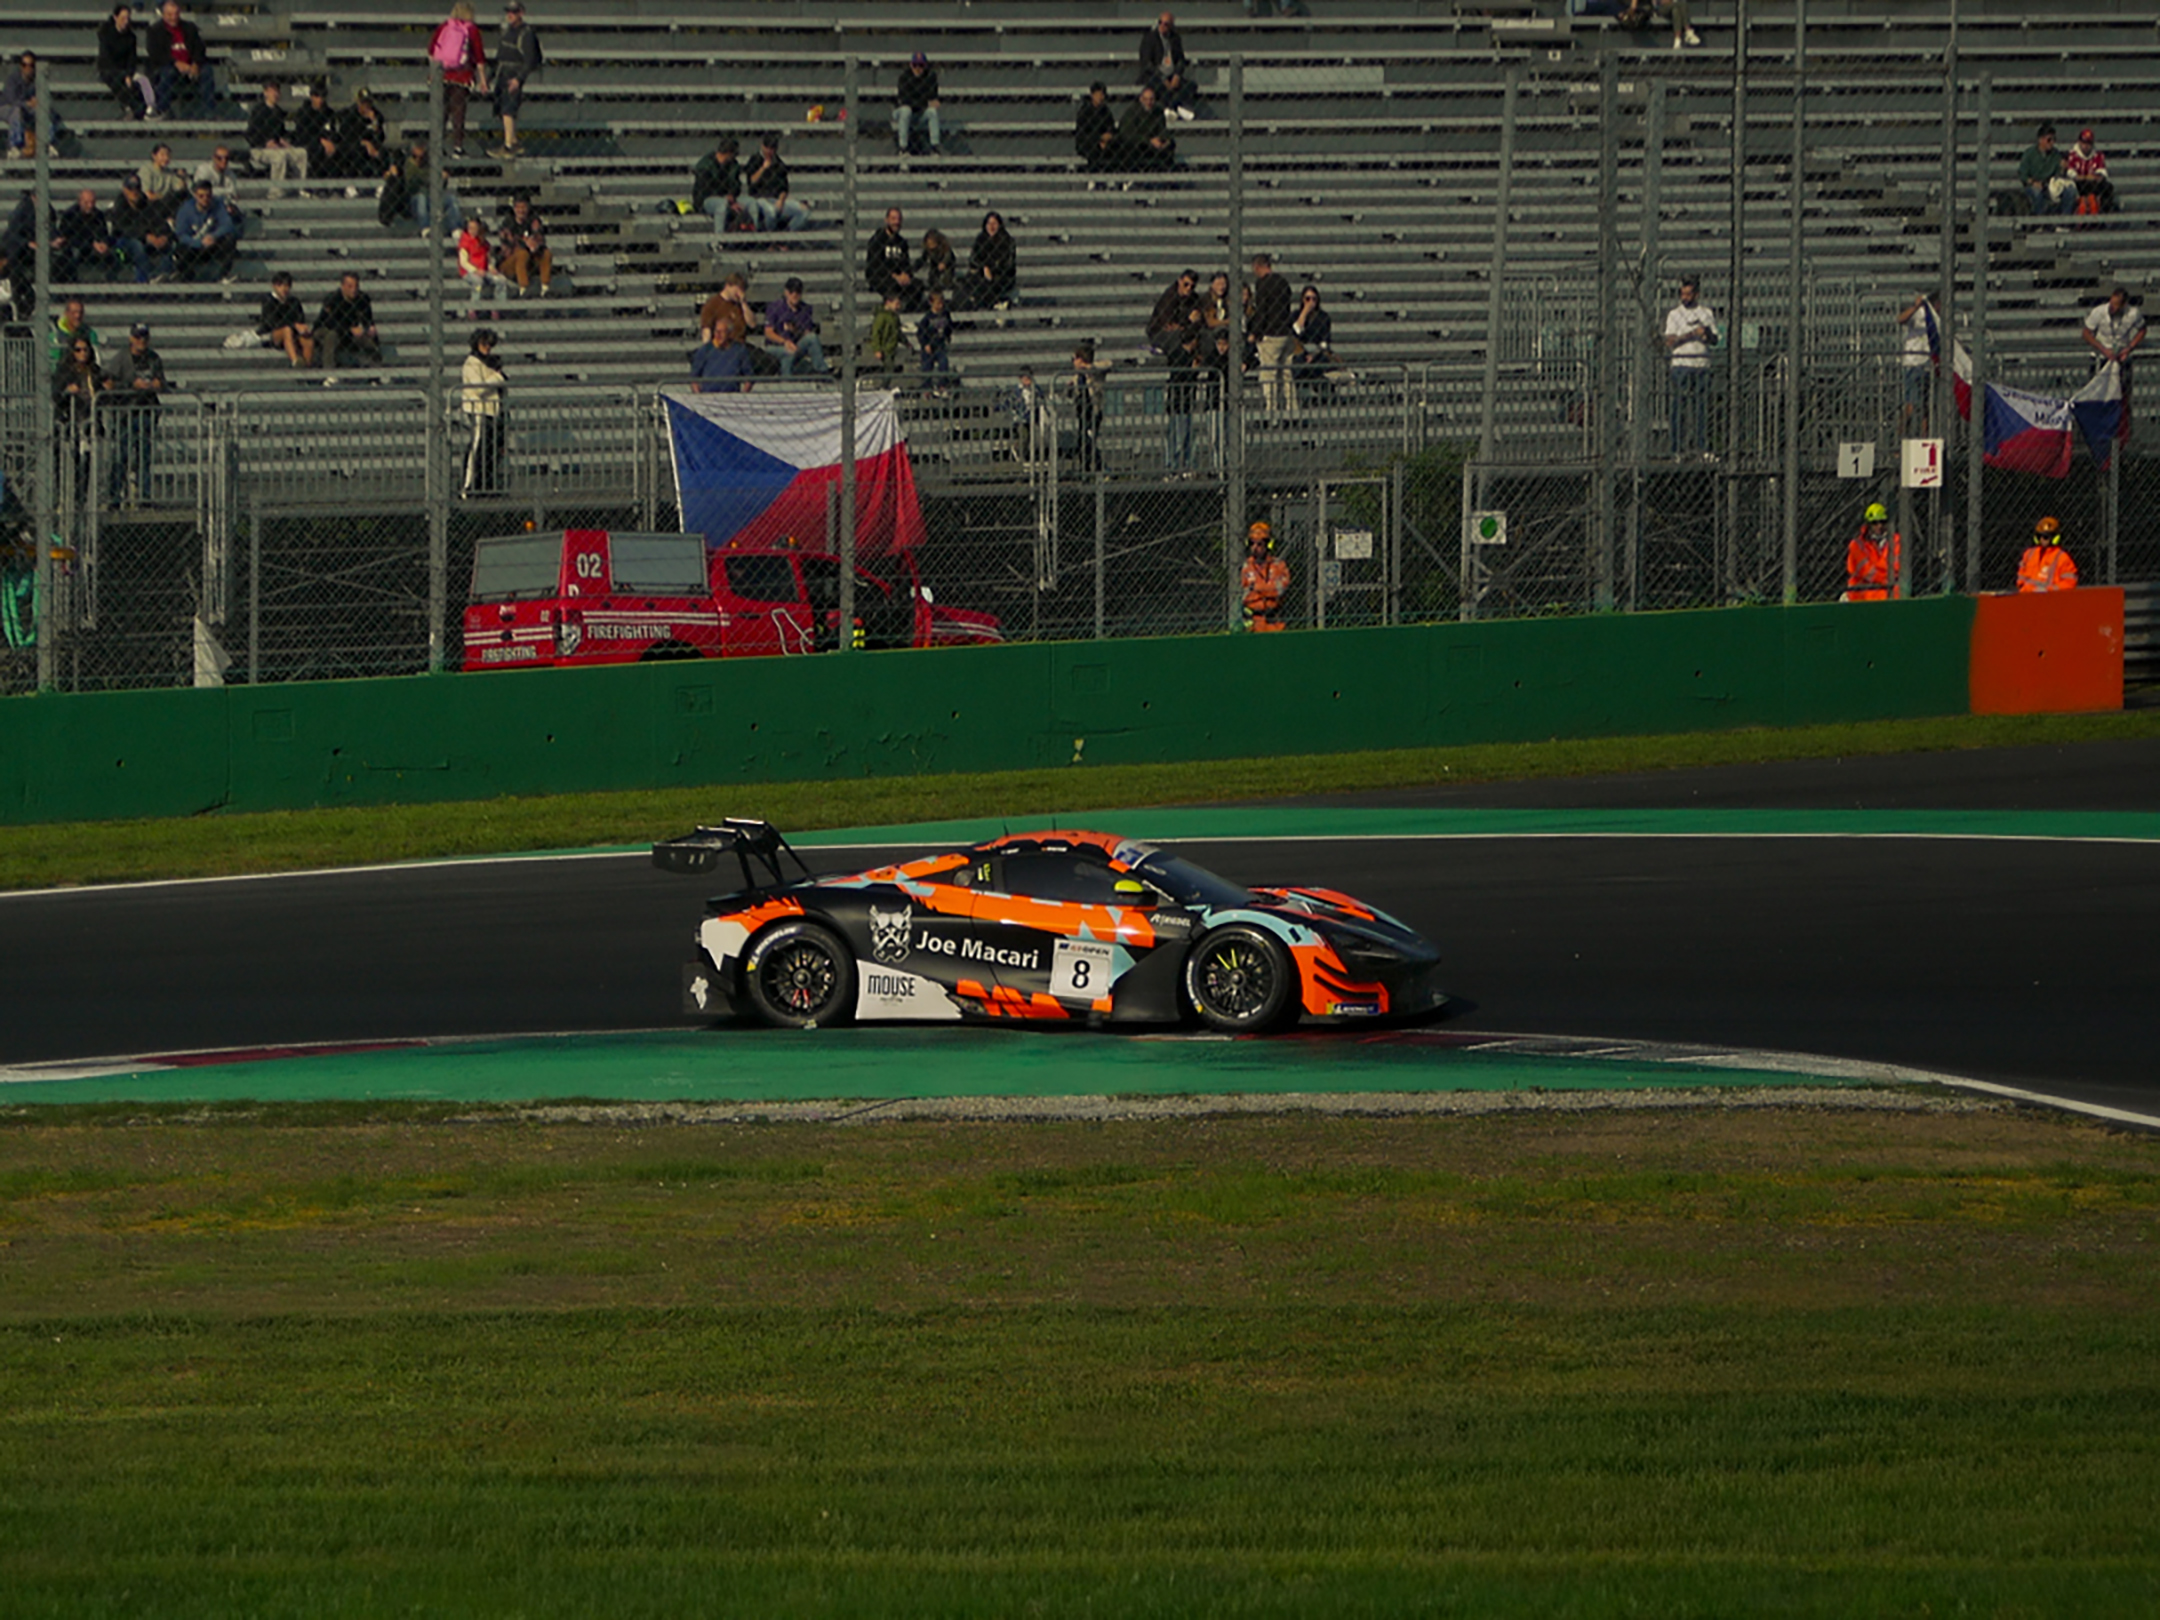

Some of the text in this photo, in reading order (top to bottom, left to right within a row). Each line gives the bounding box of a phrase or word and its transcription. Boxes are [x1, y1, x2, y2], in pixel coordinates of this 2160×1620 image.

[576, 553, 602, 578] 02
[587, 625, 671, 640] FIREFIGHTING
[915, 930, 1039, 969] Joe Macari
[867, 974, 916, 997] MOUSE
[1072, 959, 1090, 989] 8
